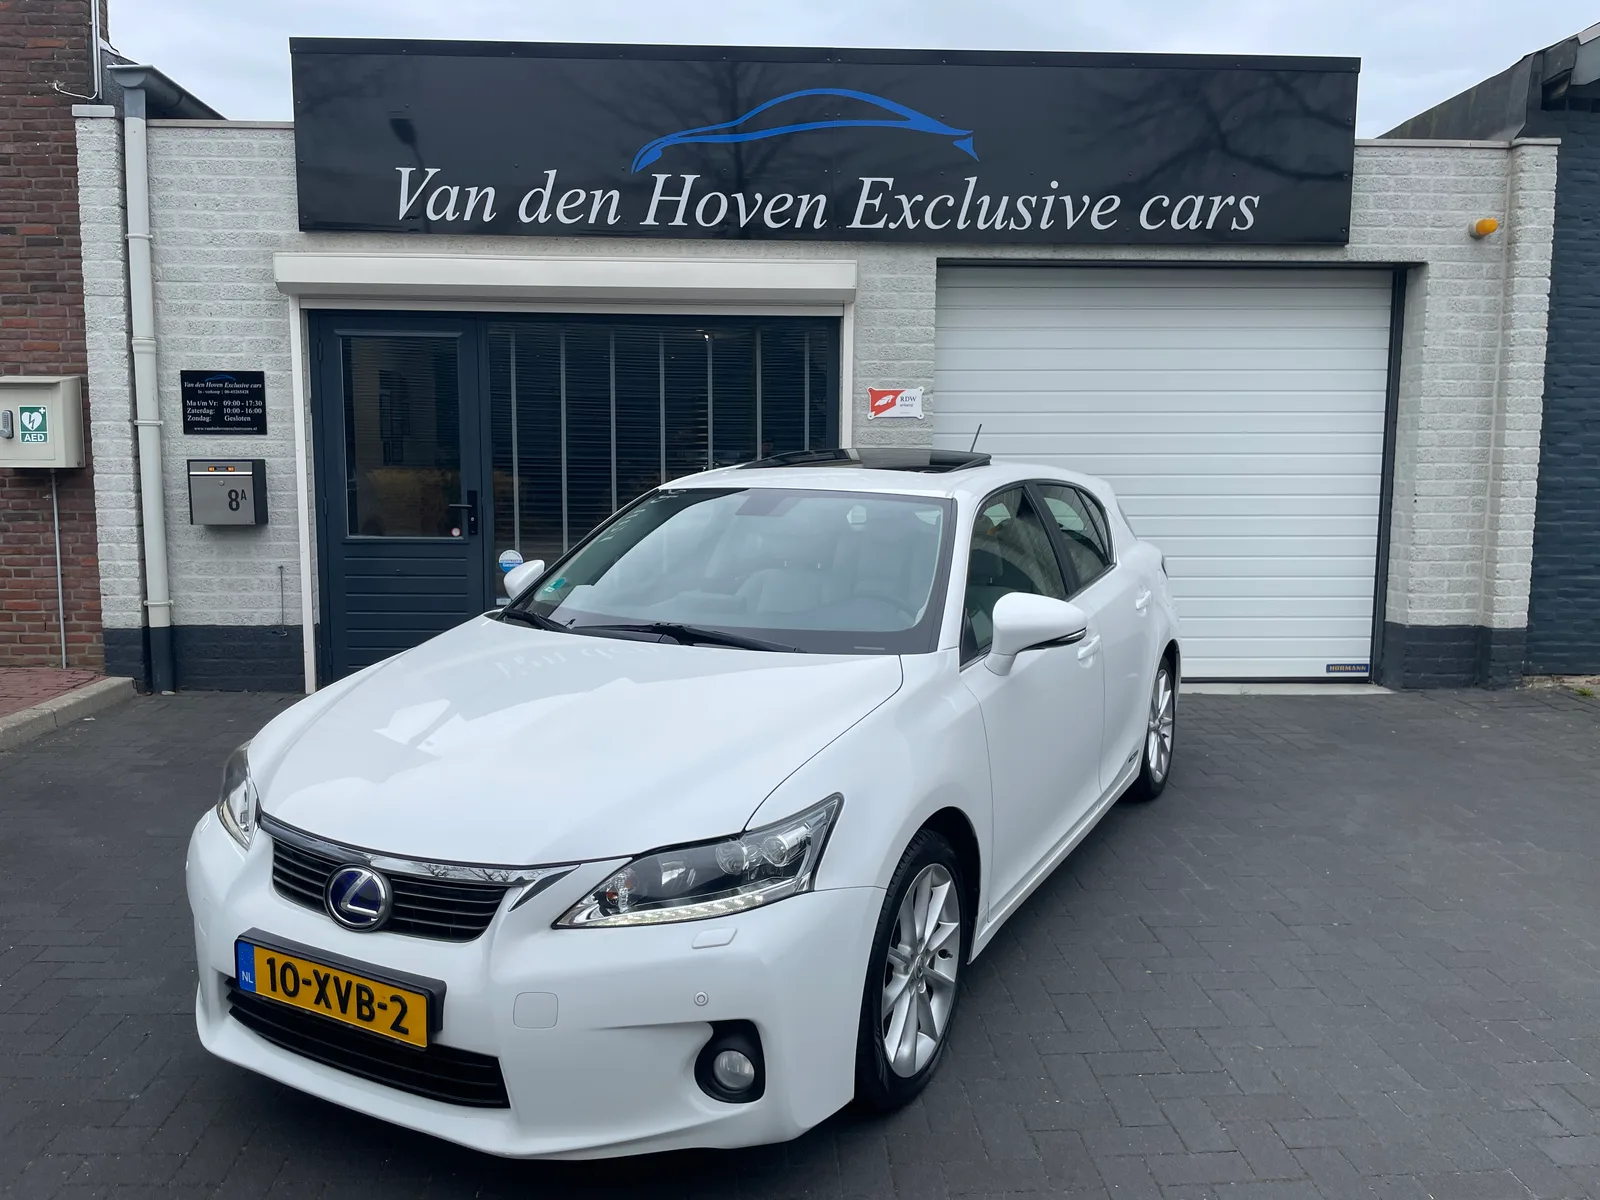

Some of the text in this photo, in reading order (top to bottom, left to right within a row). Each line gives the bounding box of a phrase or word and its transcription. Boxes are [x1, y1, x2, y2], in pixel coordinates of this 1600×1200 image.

[395, 166, 1261, 231] Van den Hoven Exclusive cars
[241, 970, 254, 983] NL
[266, 957, 409, 1035] 10-XVB-2
